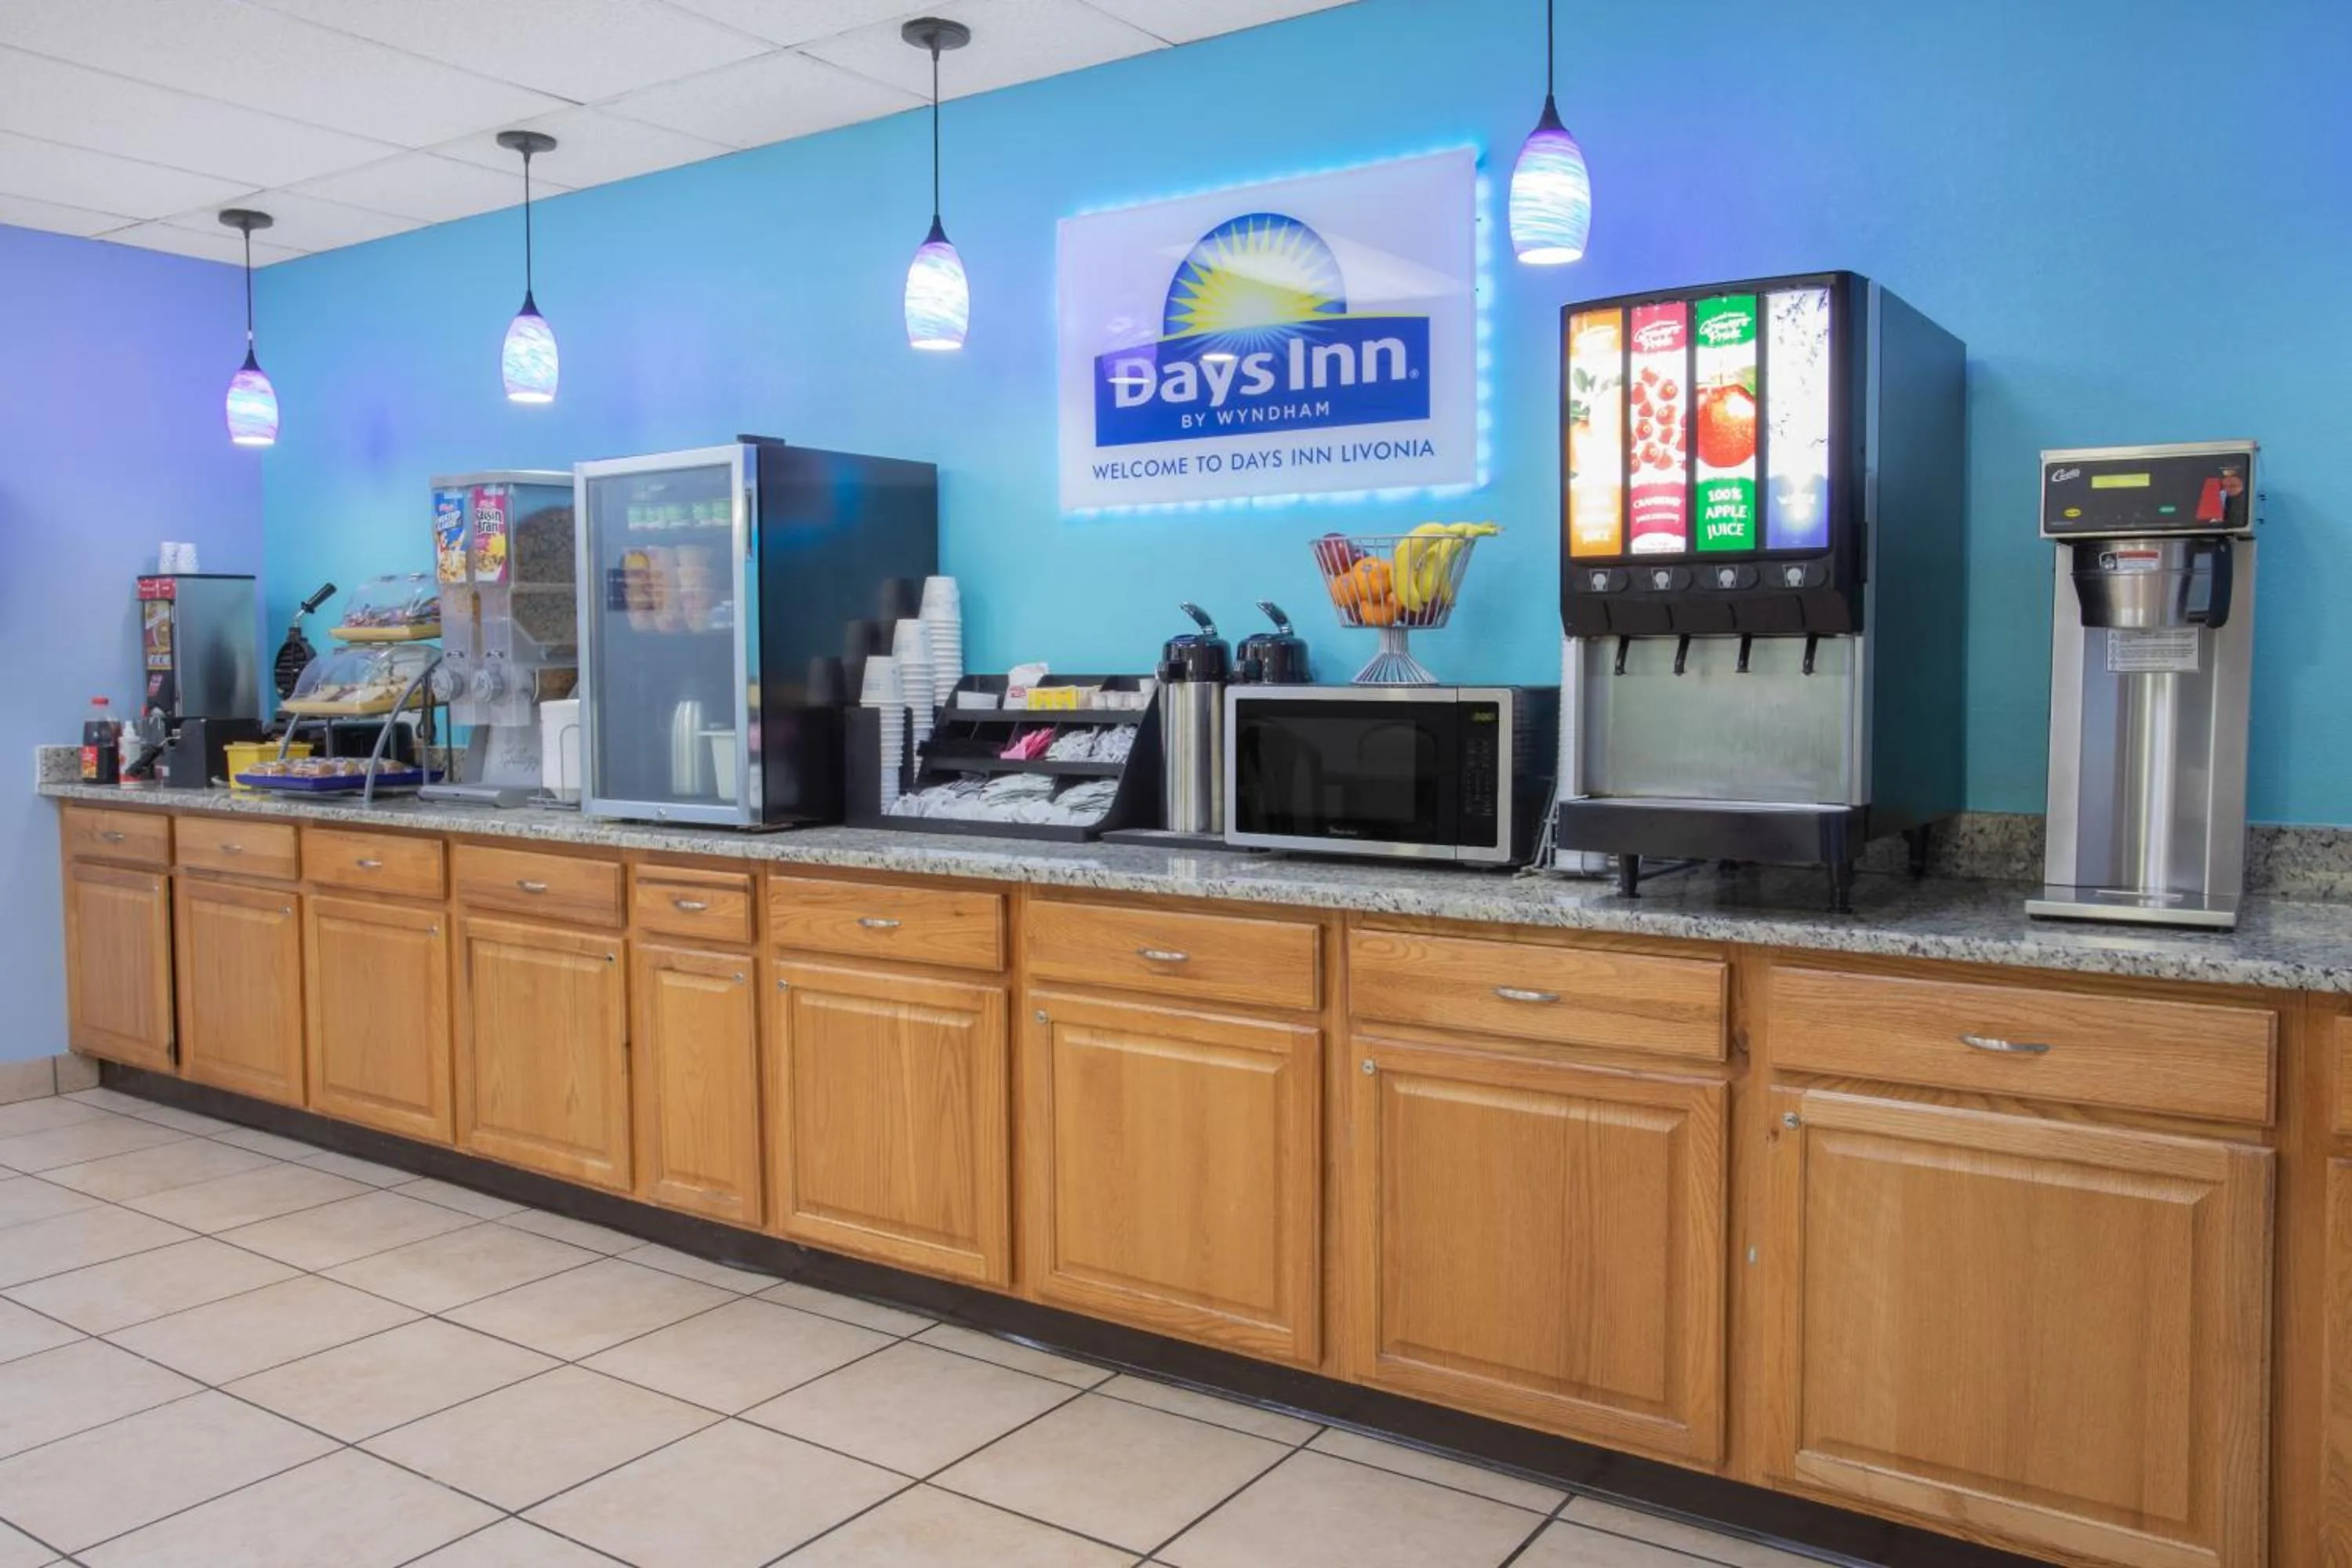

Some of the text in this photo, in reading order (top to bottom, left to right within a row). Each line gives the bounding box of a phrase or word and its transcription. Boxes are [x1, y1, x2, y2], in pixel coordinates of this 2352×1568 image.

[1116, 336, 1406, 407] Days Inn
[1181, 401, 1330, 429] BY WYNDHAM
[1093, 439, 1435, 480] WELCOME TO DAYS INN LIVONIA
[1708, 488, 1742, 502] 100%
[1705, 505, 1748, 519] APPLE
[1707, 522, 1745, 539] JUICE
